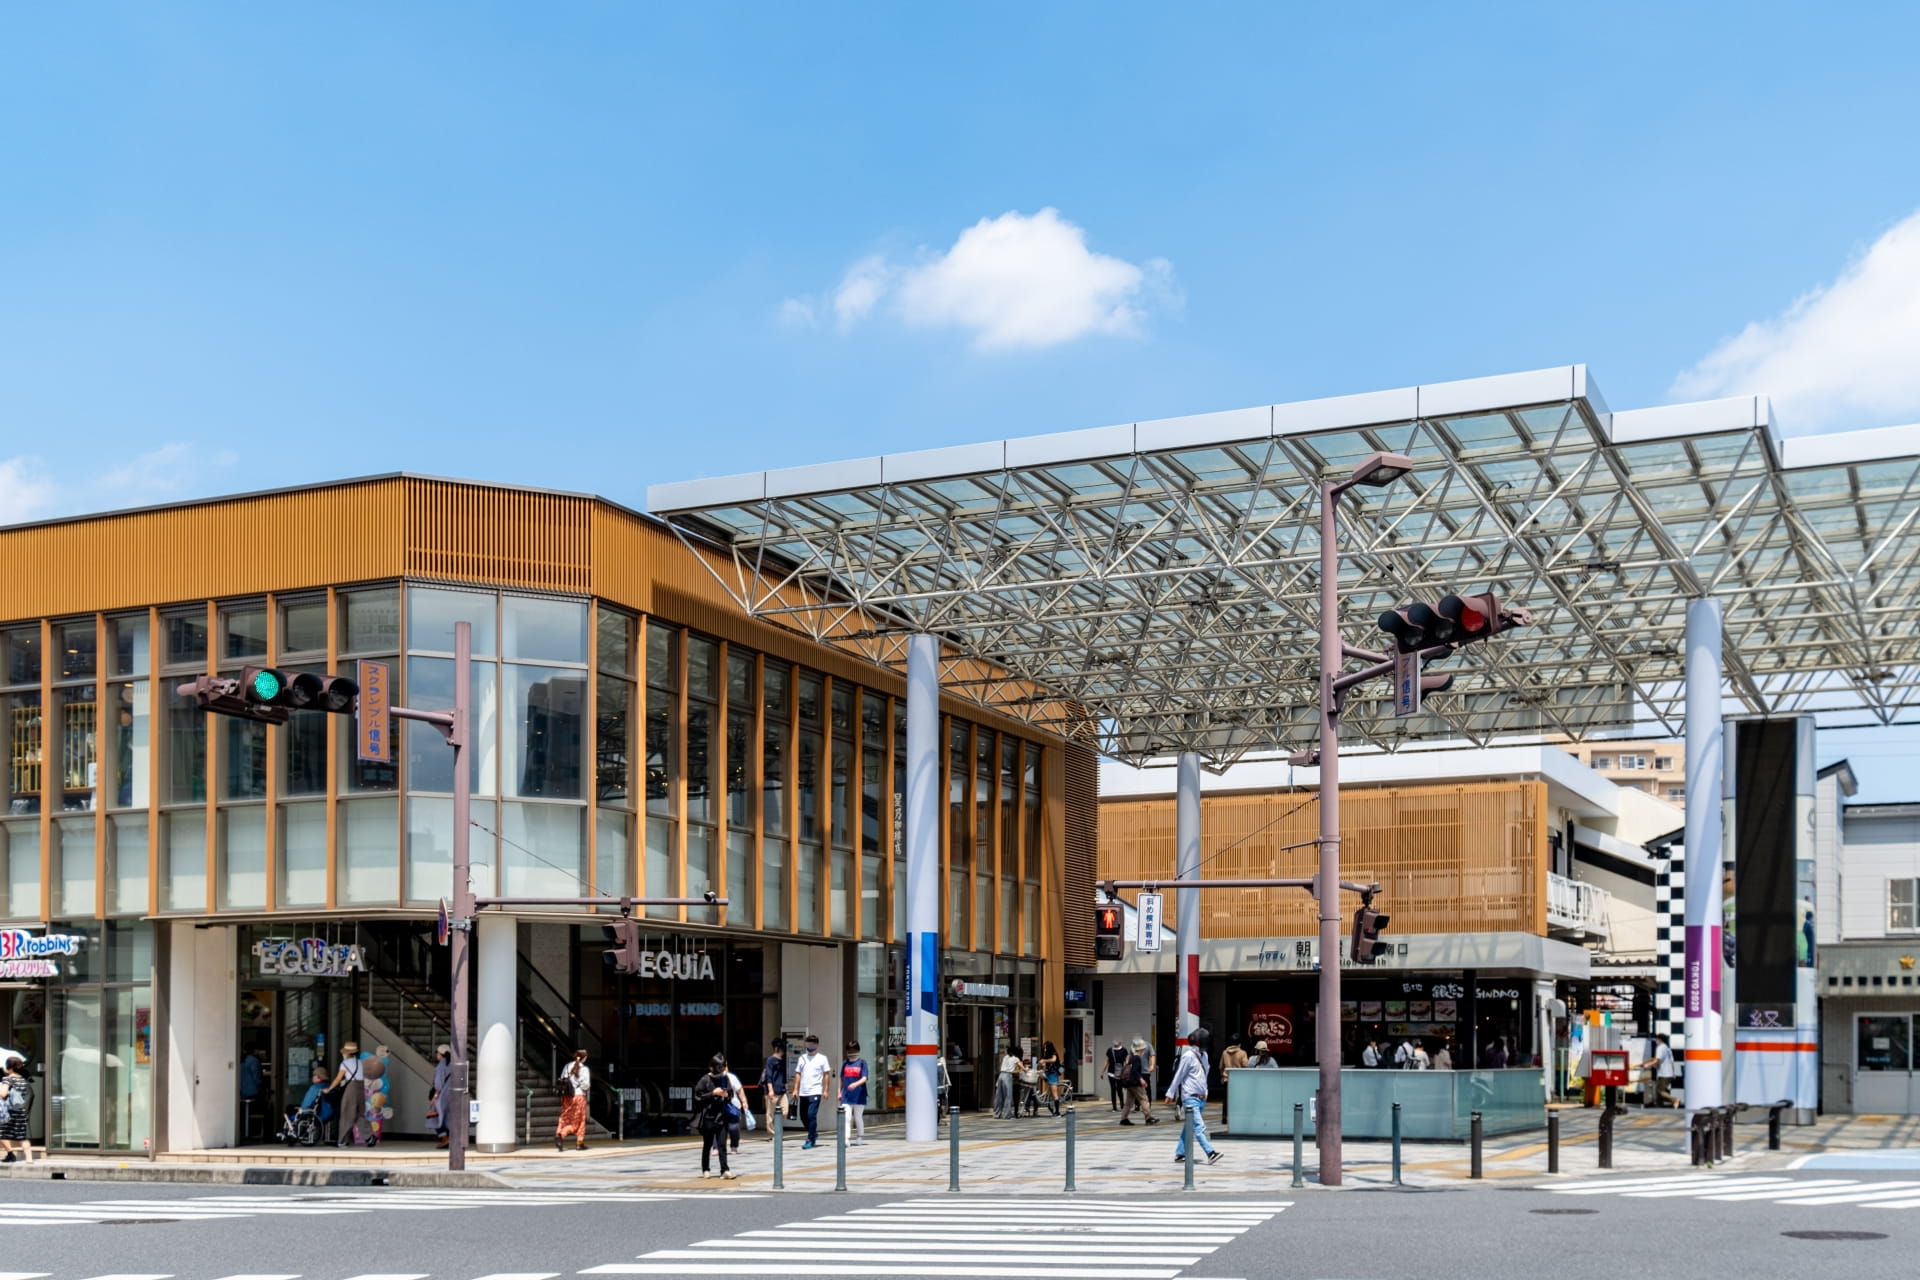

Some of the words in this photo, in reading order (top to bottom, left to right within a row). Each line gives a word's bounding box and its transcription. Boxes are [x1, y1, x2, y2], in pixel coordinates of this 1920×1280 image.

[368, 666, 381, 755] スクランブル信号
[26, 937, 72, 953] robbins
[8, 962, 51, 975] アイスクリーム
[1691, 961, 1700, 989] TOKYO
[687, 1003, 721, 1016] KING
[1691, 990, 1700, 1012] 2020
